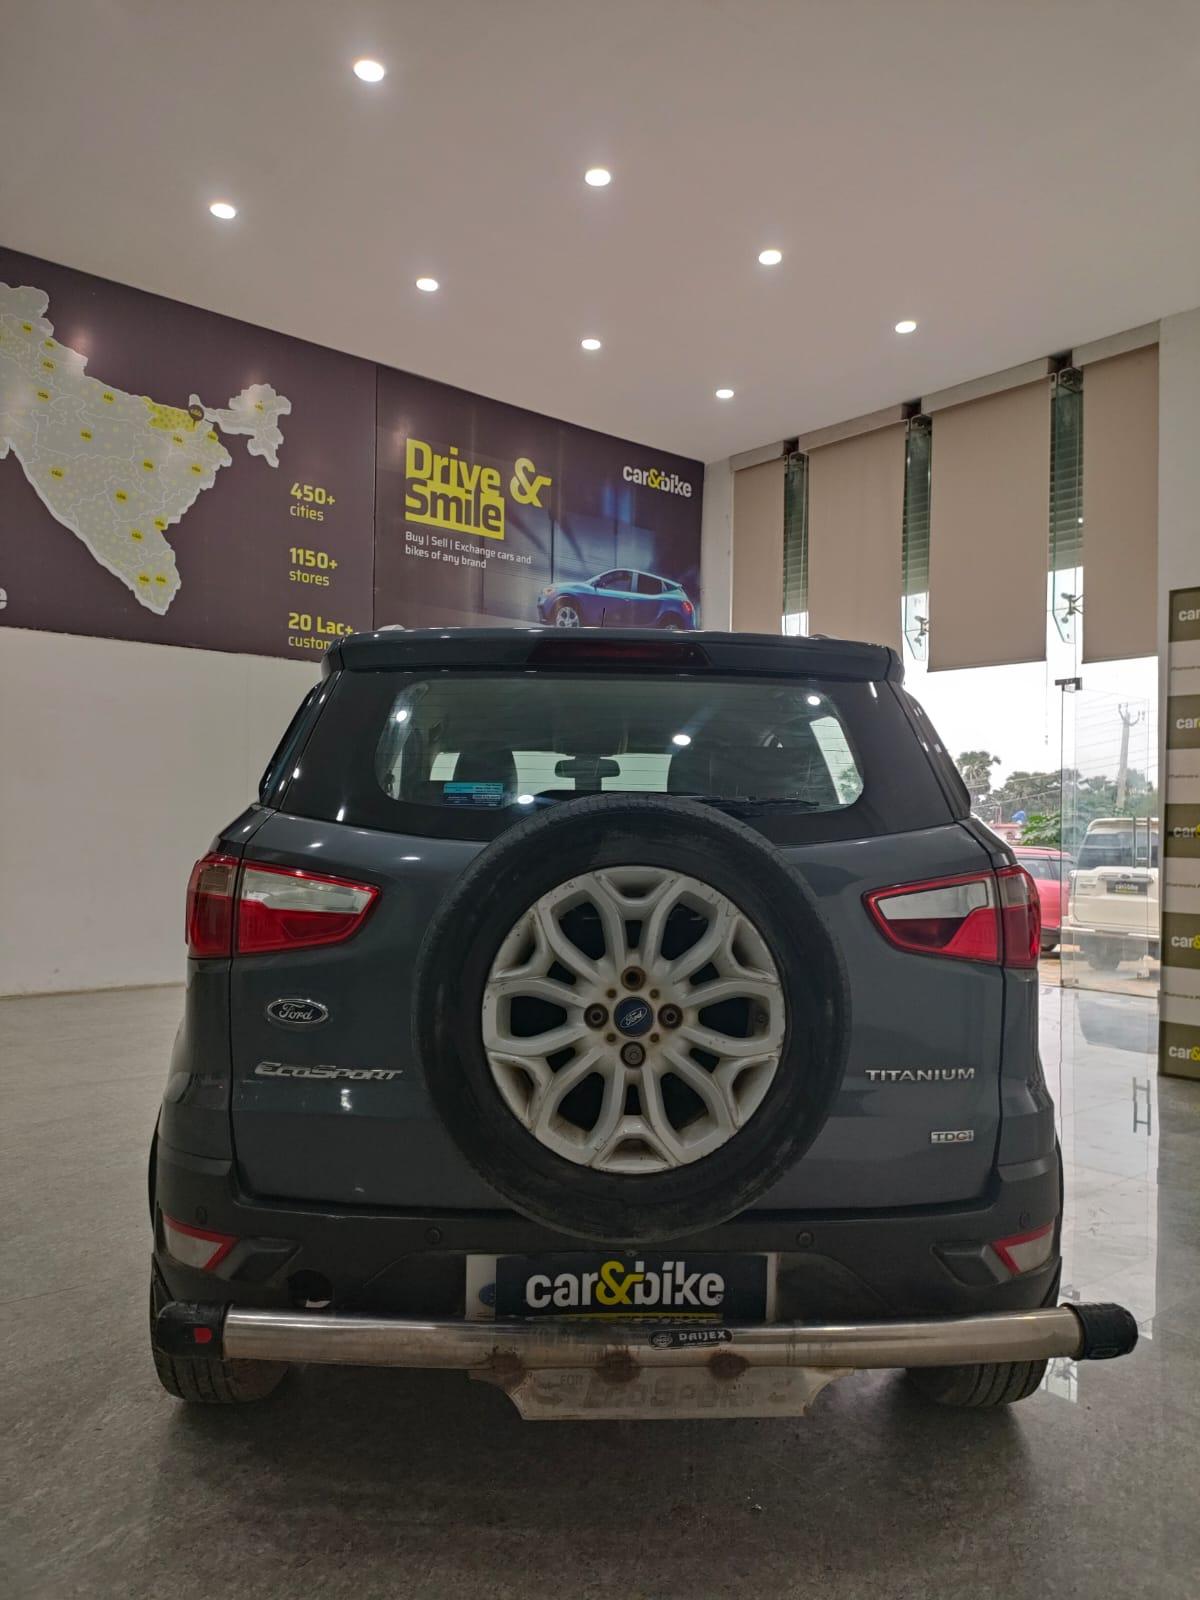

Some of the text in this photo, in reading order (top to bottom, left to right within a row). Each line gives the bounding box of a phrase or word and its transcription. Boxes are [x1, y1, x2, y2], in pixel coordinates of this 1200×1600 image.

[406, 438, 552, 508] Drive &
[623, 465, 692, 498] car&bike
[289, 482, 336, 506] 450+
[290, 503, 324, 521] cities
[405, 477, 503, 537] Smile
[289, 547, 338, 570] 1150+
[405, 531, 424, 546] Buy
[431, 536, 448, 549] Sell
[454, 541, 496, 559] Exchange
[497, 551, 515, 562] cars
[515, 554, 532, 565] and
[405, 544, 487, 569] bikes of any brand
[289, 569, 330, 586] stores
[288, 612, 353, 636] 20 Lac+
[279, 1002, 315, 1021] Ford
[865, 1068, 975, 1081] TITANIUM
[525, 1259, 725, 1308] car&bike
